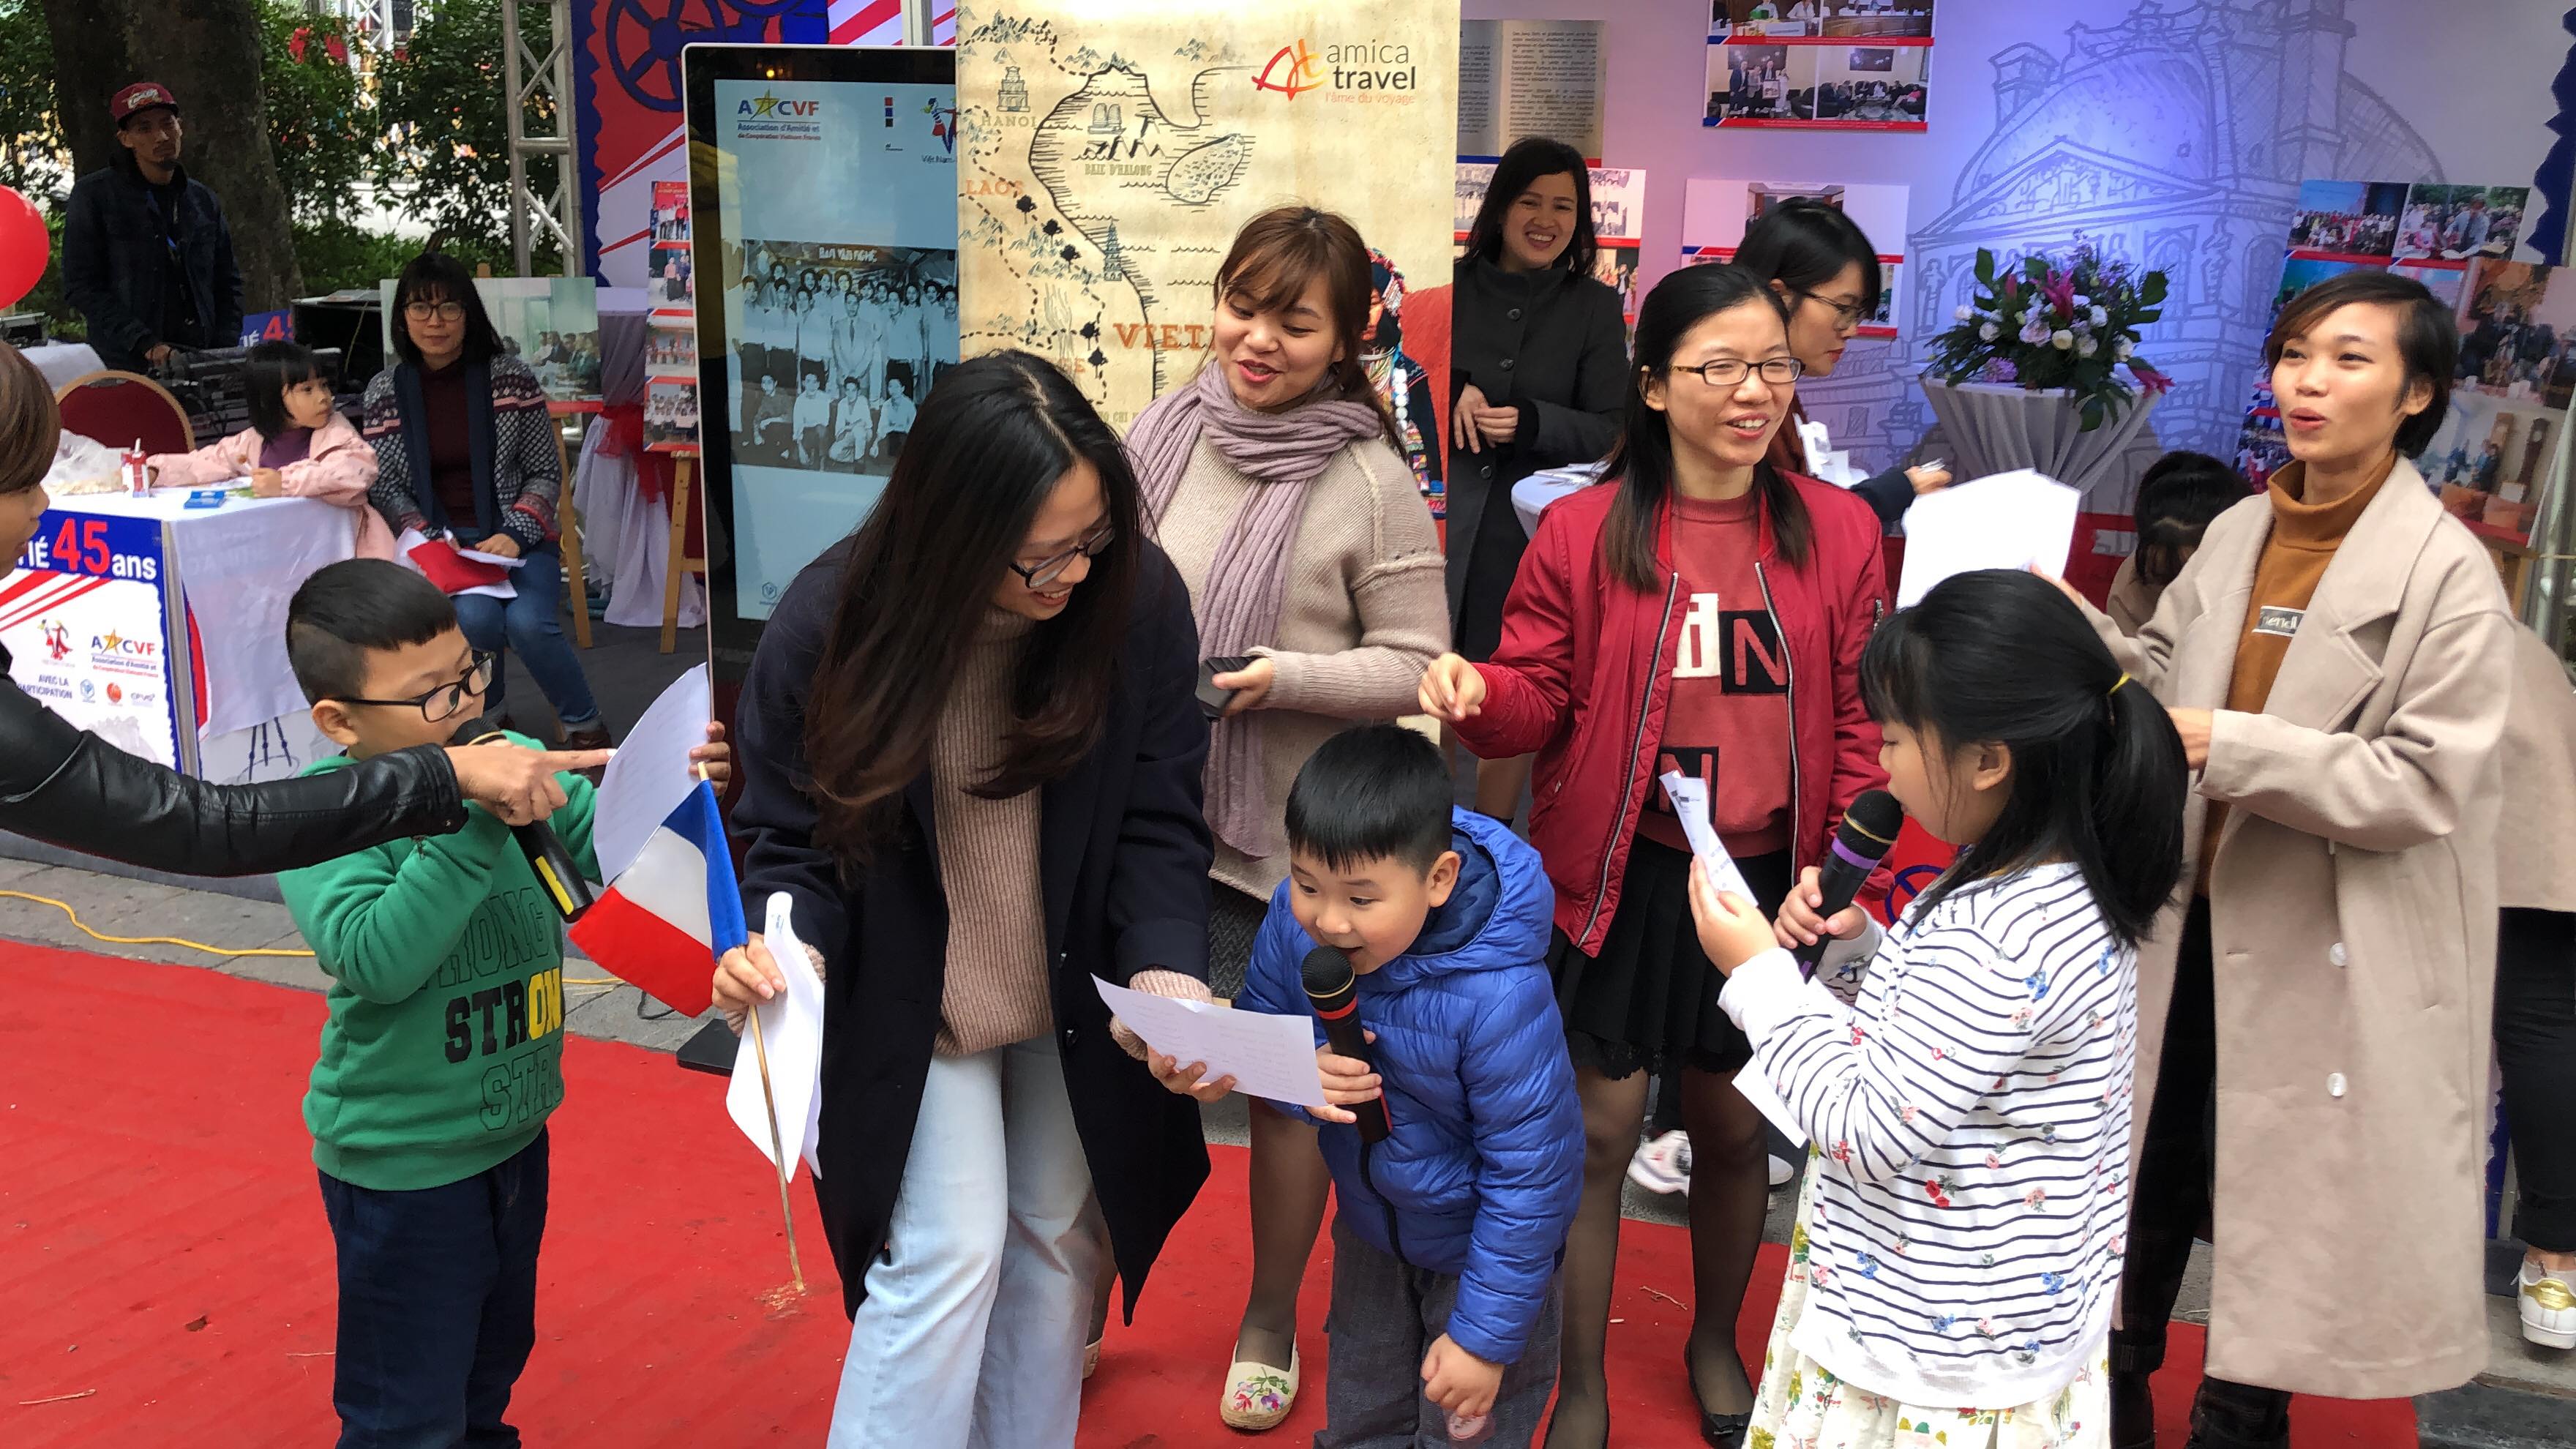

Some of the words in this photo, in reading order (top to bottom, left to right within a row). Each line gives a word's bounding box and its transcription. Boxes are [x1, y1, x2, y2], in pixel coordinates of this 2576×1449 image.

[1326, 39, 1409, 64] amica
[1333, 65, 1416, 90] travel
[1358, 92, 1372, 103] du
[1377, 94, 1416, 105] voyage
[981, 116, 1038, 128] HANOI
[966, 179, 1024, 197] LAOS
[53, 518, 110, 574] 45
[112, 553, 157, 580] ans
